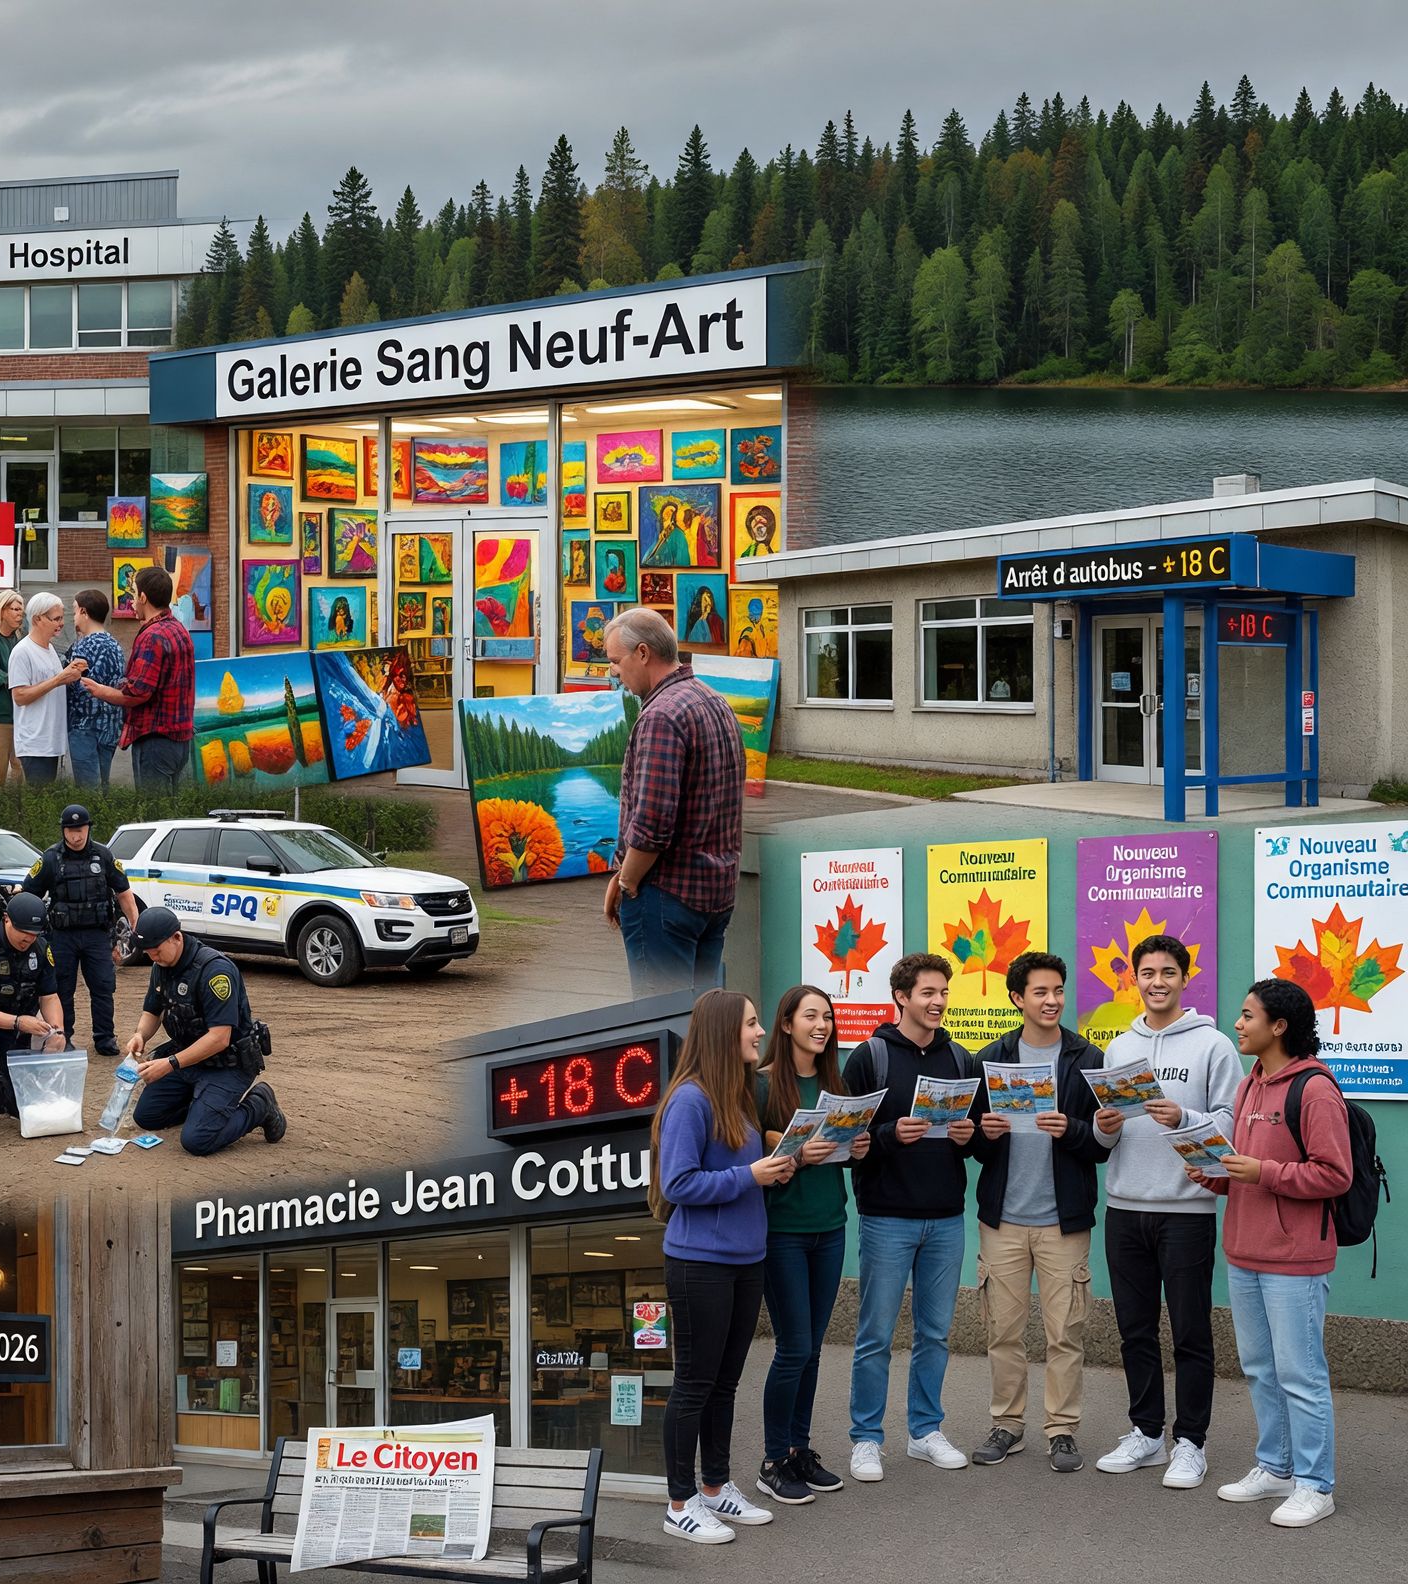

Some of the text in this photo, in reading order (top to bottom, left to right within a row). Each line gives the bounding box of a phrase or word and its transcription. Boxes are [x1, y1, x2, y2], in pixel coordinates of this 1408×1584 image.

[8, 237, 130, 272] Hospital
[227, 297, 744, 402] Galerie Sang Neuf-Art
[1004, 564, 1048, 589] Arrêt
[1208, 547, 1225, 575] C
[1262, 615, 1273, 638] C
[1299, 837, 1377, 855] Nouveau
[1105, 864, 1187, 885] Organisme
[1289, 859, 1390, 880] Organisme
[1267, 878, 1408, 899] Communautaire
[210, 893, 258, 922] SPQ
[500, 1046, 654, 1118] +18 C
[194, 1143, 651, 1240] Pharmacie Jean Cottu
[335, 1442, 478, 1477] Le Citoyen
